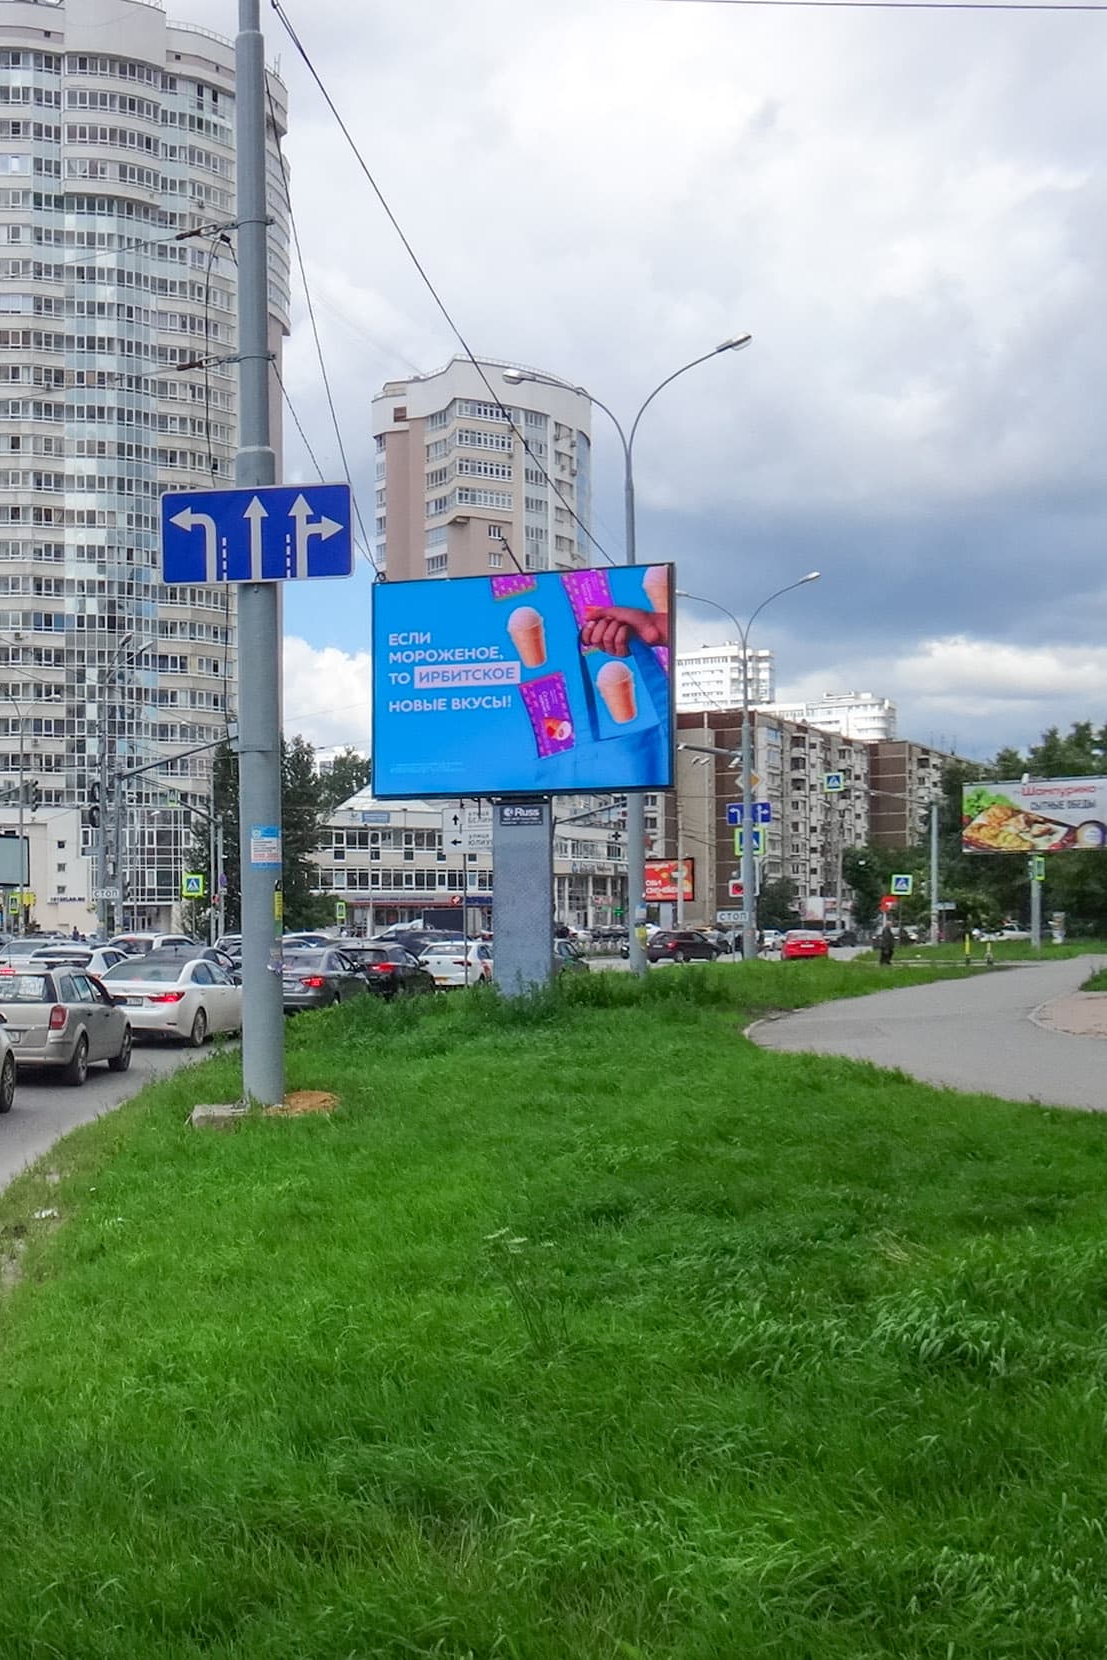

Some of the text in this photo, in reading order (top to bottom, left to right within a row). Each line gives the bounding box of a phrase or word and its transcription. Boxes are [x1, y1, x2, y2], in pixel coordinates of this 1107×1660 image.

[388, 631, 431, 646] ЕСЛИ
[388, 646, 504, 664] МОРОЖЕНОЕ,
[388, 666, 516, 685] ТО ИРБИТСКОЕ
[388, 695, 512, 713] НОВЫЕ ВКУСЫ!
[514, 807, 541, 817] Russ
[719, 912, 747, 921] СТОП
